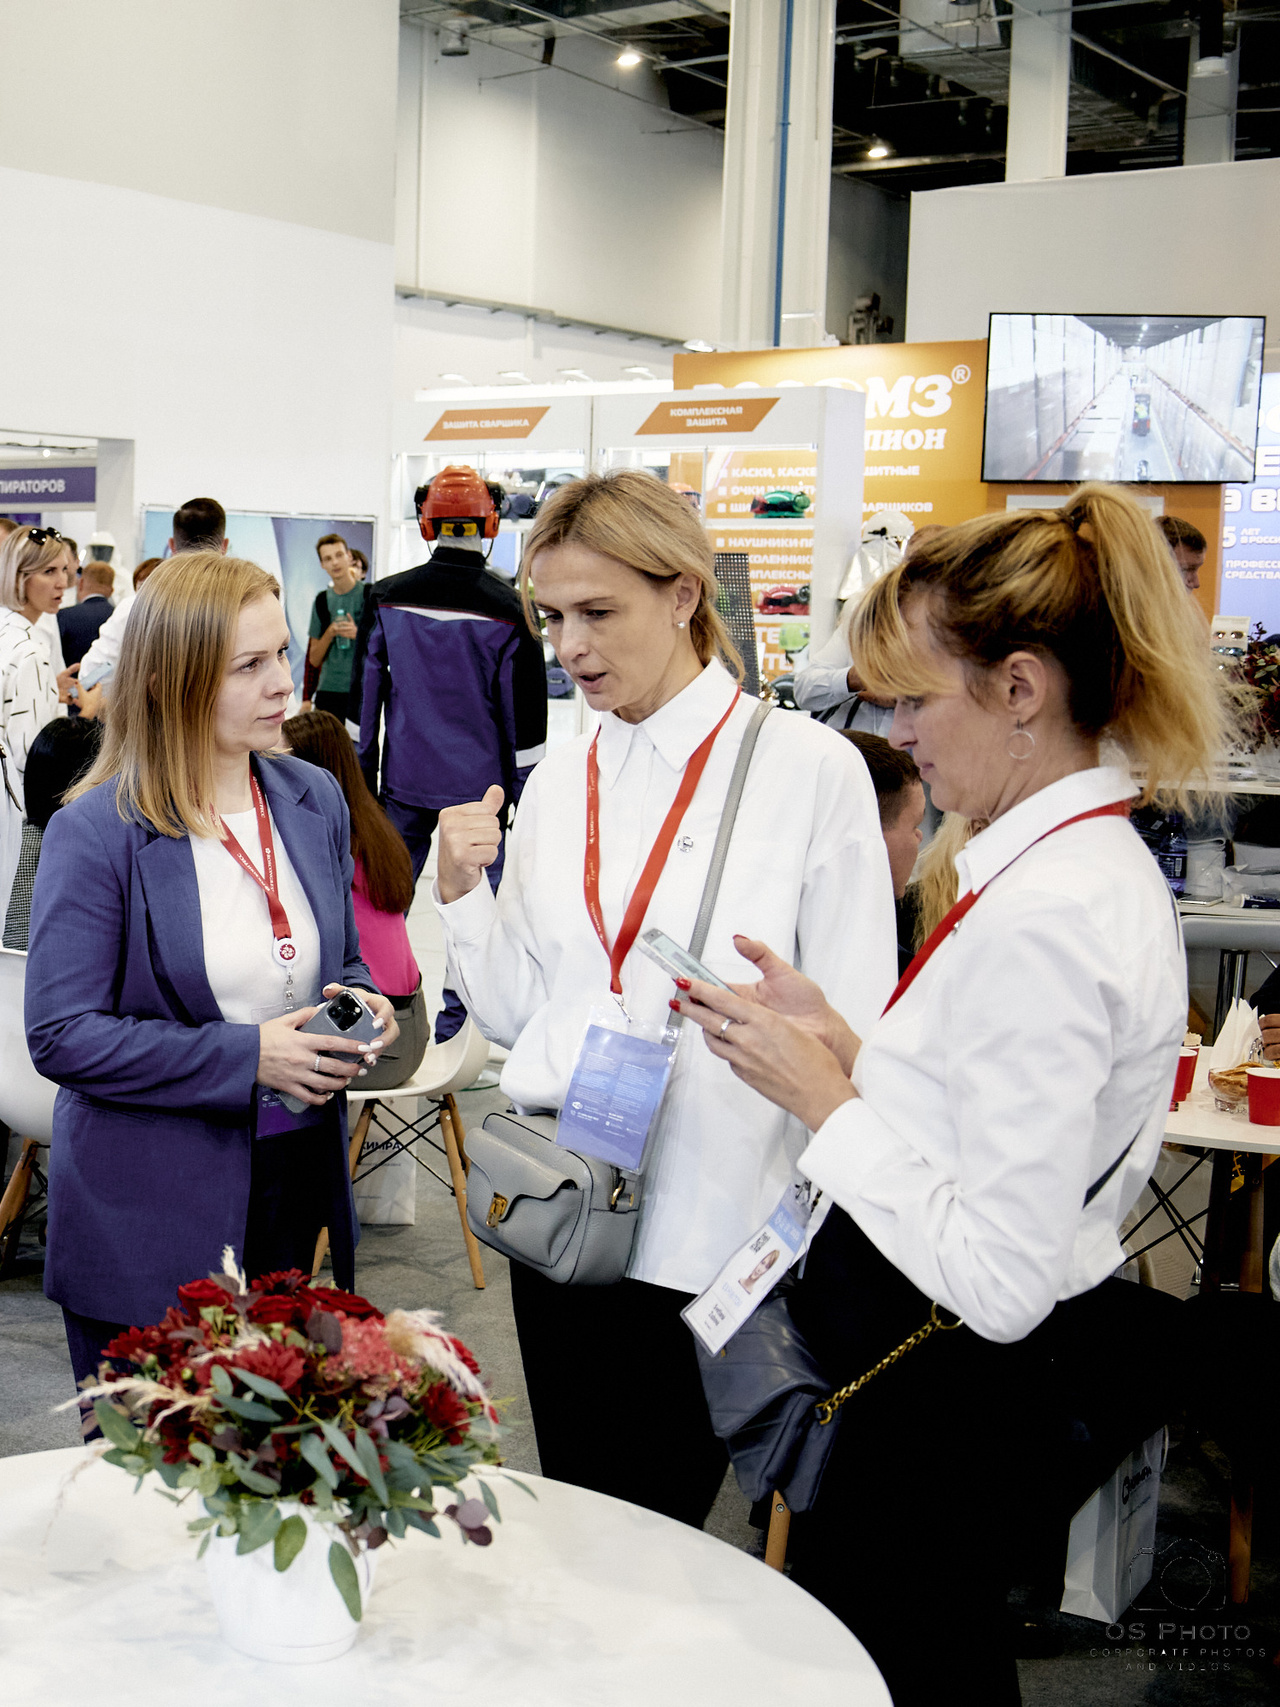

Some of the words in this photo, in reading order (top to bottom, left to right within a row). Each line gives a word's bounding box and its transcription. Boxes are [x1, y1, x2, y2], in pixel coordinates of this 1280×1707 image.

[669, 406, 744, 417] КОМПЛЕКСНАЯ
[443, 420, 479, 429] ЗАЩИТА
[686, 417, 728, 428] ЗАЩИТА
[777, 466, 817, 477] КАСКЕ
[1240, 527, 1261, 536] ЛЕТ
